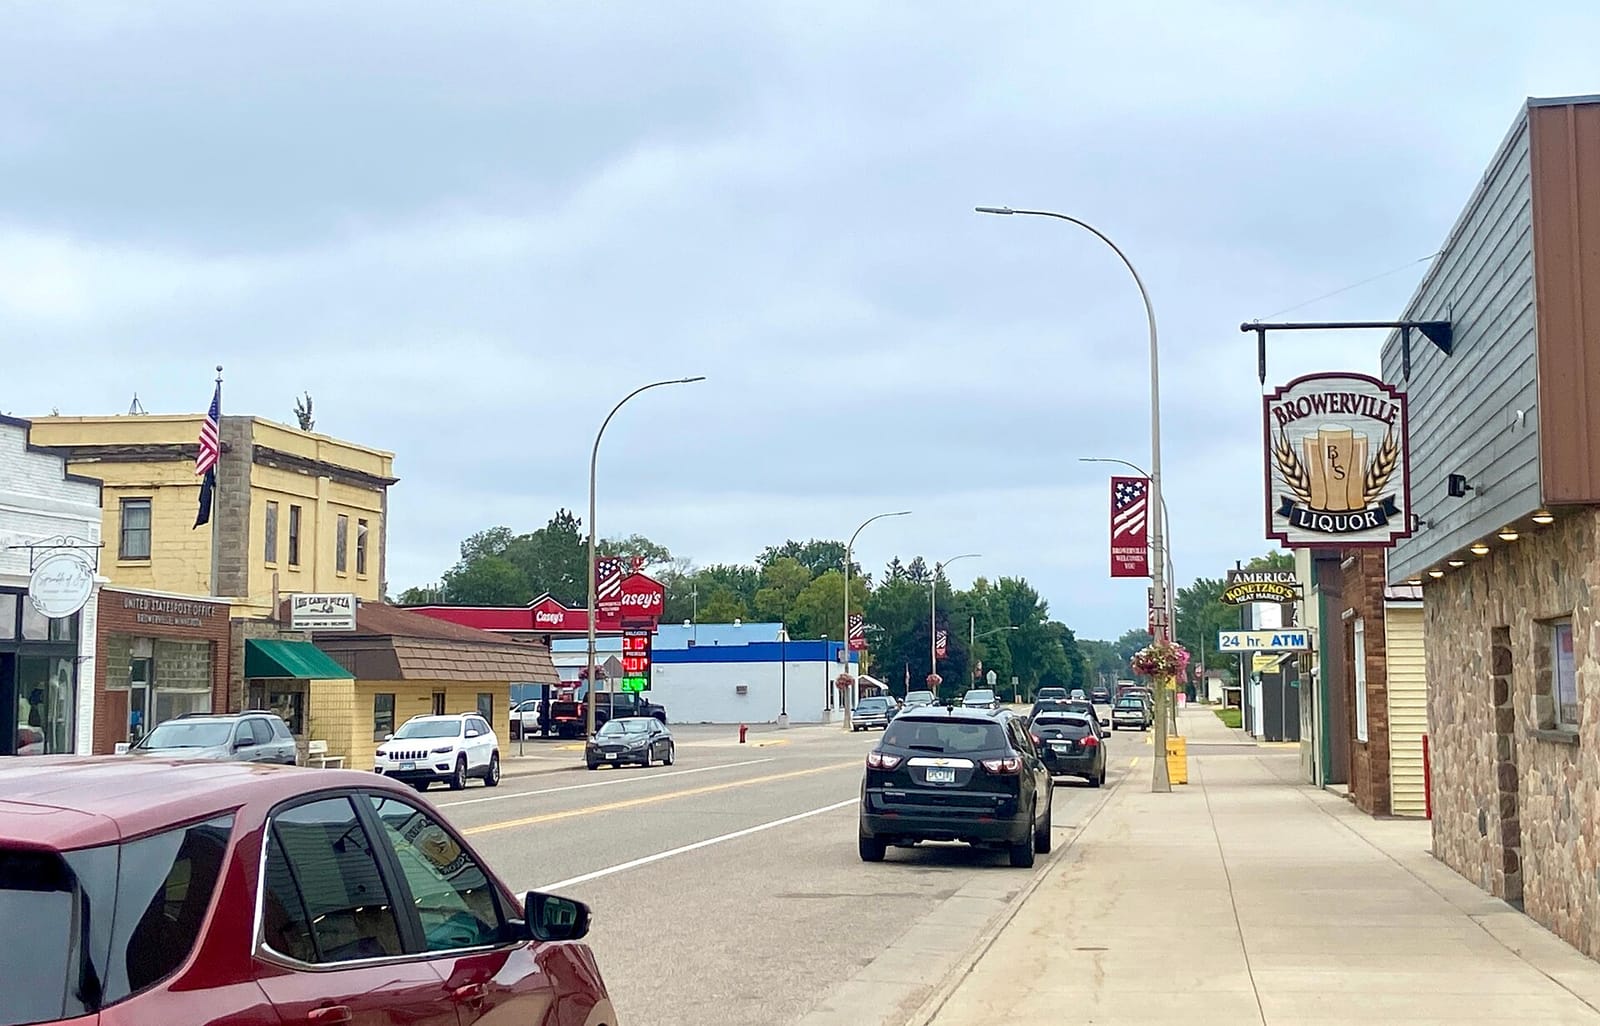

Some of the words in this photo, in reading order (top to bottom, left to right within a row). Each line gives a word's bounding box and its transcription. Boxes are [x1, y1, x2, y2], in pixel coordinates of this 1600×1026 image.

[1272, 393, 1399, 426] BROWERVILLE
[1300, 511, 1379, 532] LIQUOR
[1124, 562, 1136, 570] YOU
[620, 590, 661, 609] asey's
[1226, 583, 1294, 601] KONETZKO'S
[1236, 593, 1254, 604] MEAT
[1255, 593, 1285, 602] MARKET
[123, 597, 149, 610] UNITED
[151, 600, 173, 612] STATES
[174, 602, 191, 614] POST
[192, 604, 216, 617] OFFICE
[536, 610, 564, 625] Casey's
[1222, 635, 1240, 647] 24
[1246, 635, 1265, 647] hr.
[1271, 634, 1304, 647] ATM
